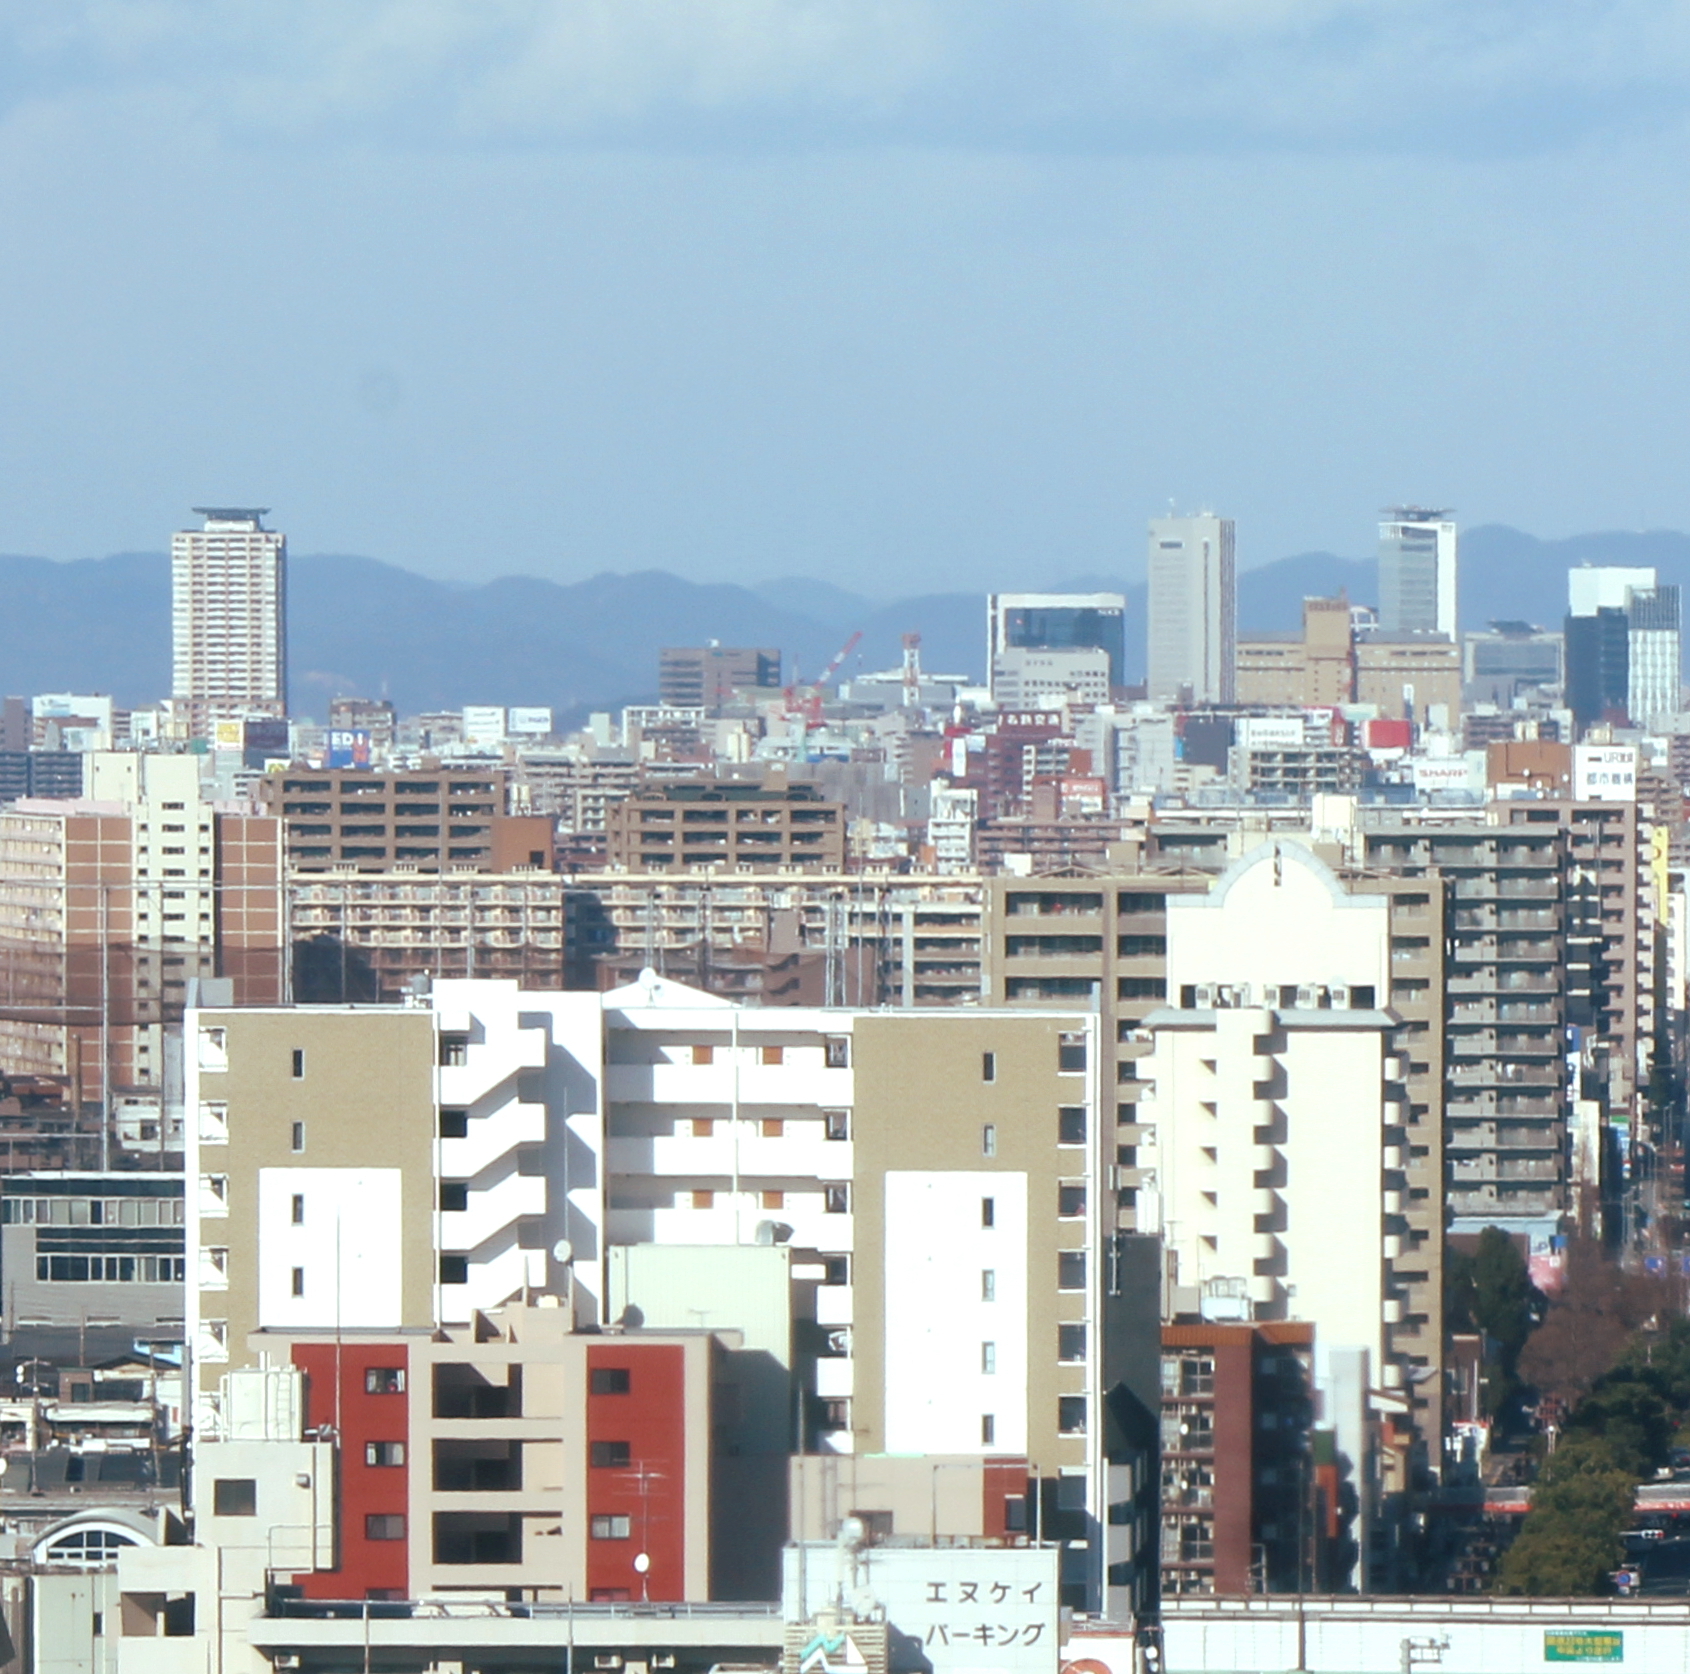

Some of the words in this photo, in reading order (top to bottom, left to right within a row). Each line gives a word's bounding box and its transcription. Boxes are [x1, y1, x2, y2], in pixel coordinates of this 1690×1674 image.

[925, 1581, 1043, 1604] エヌケイ
[925, 1622, 1047, 1647] パーキング
